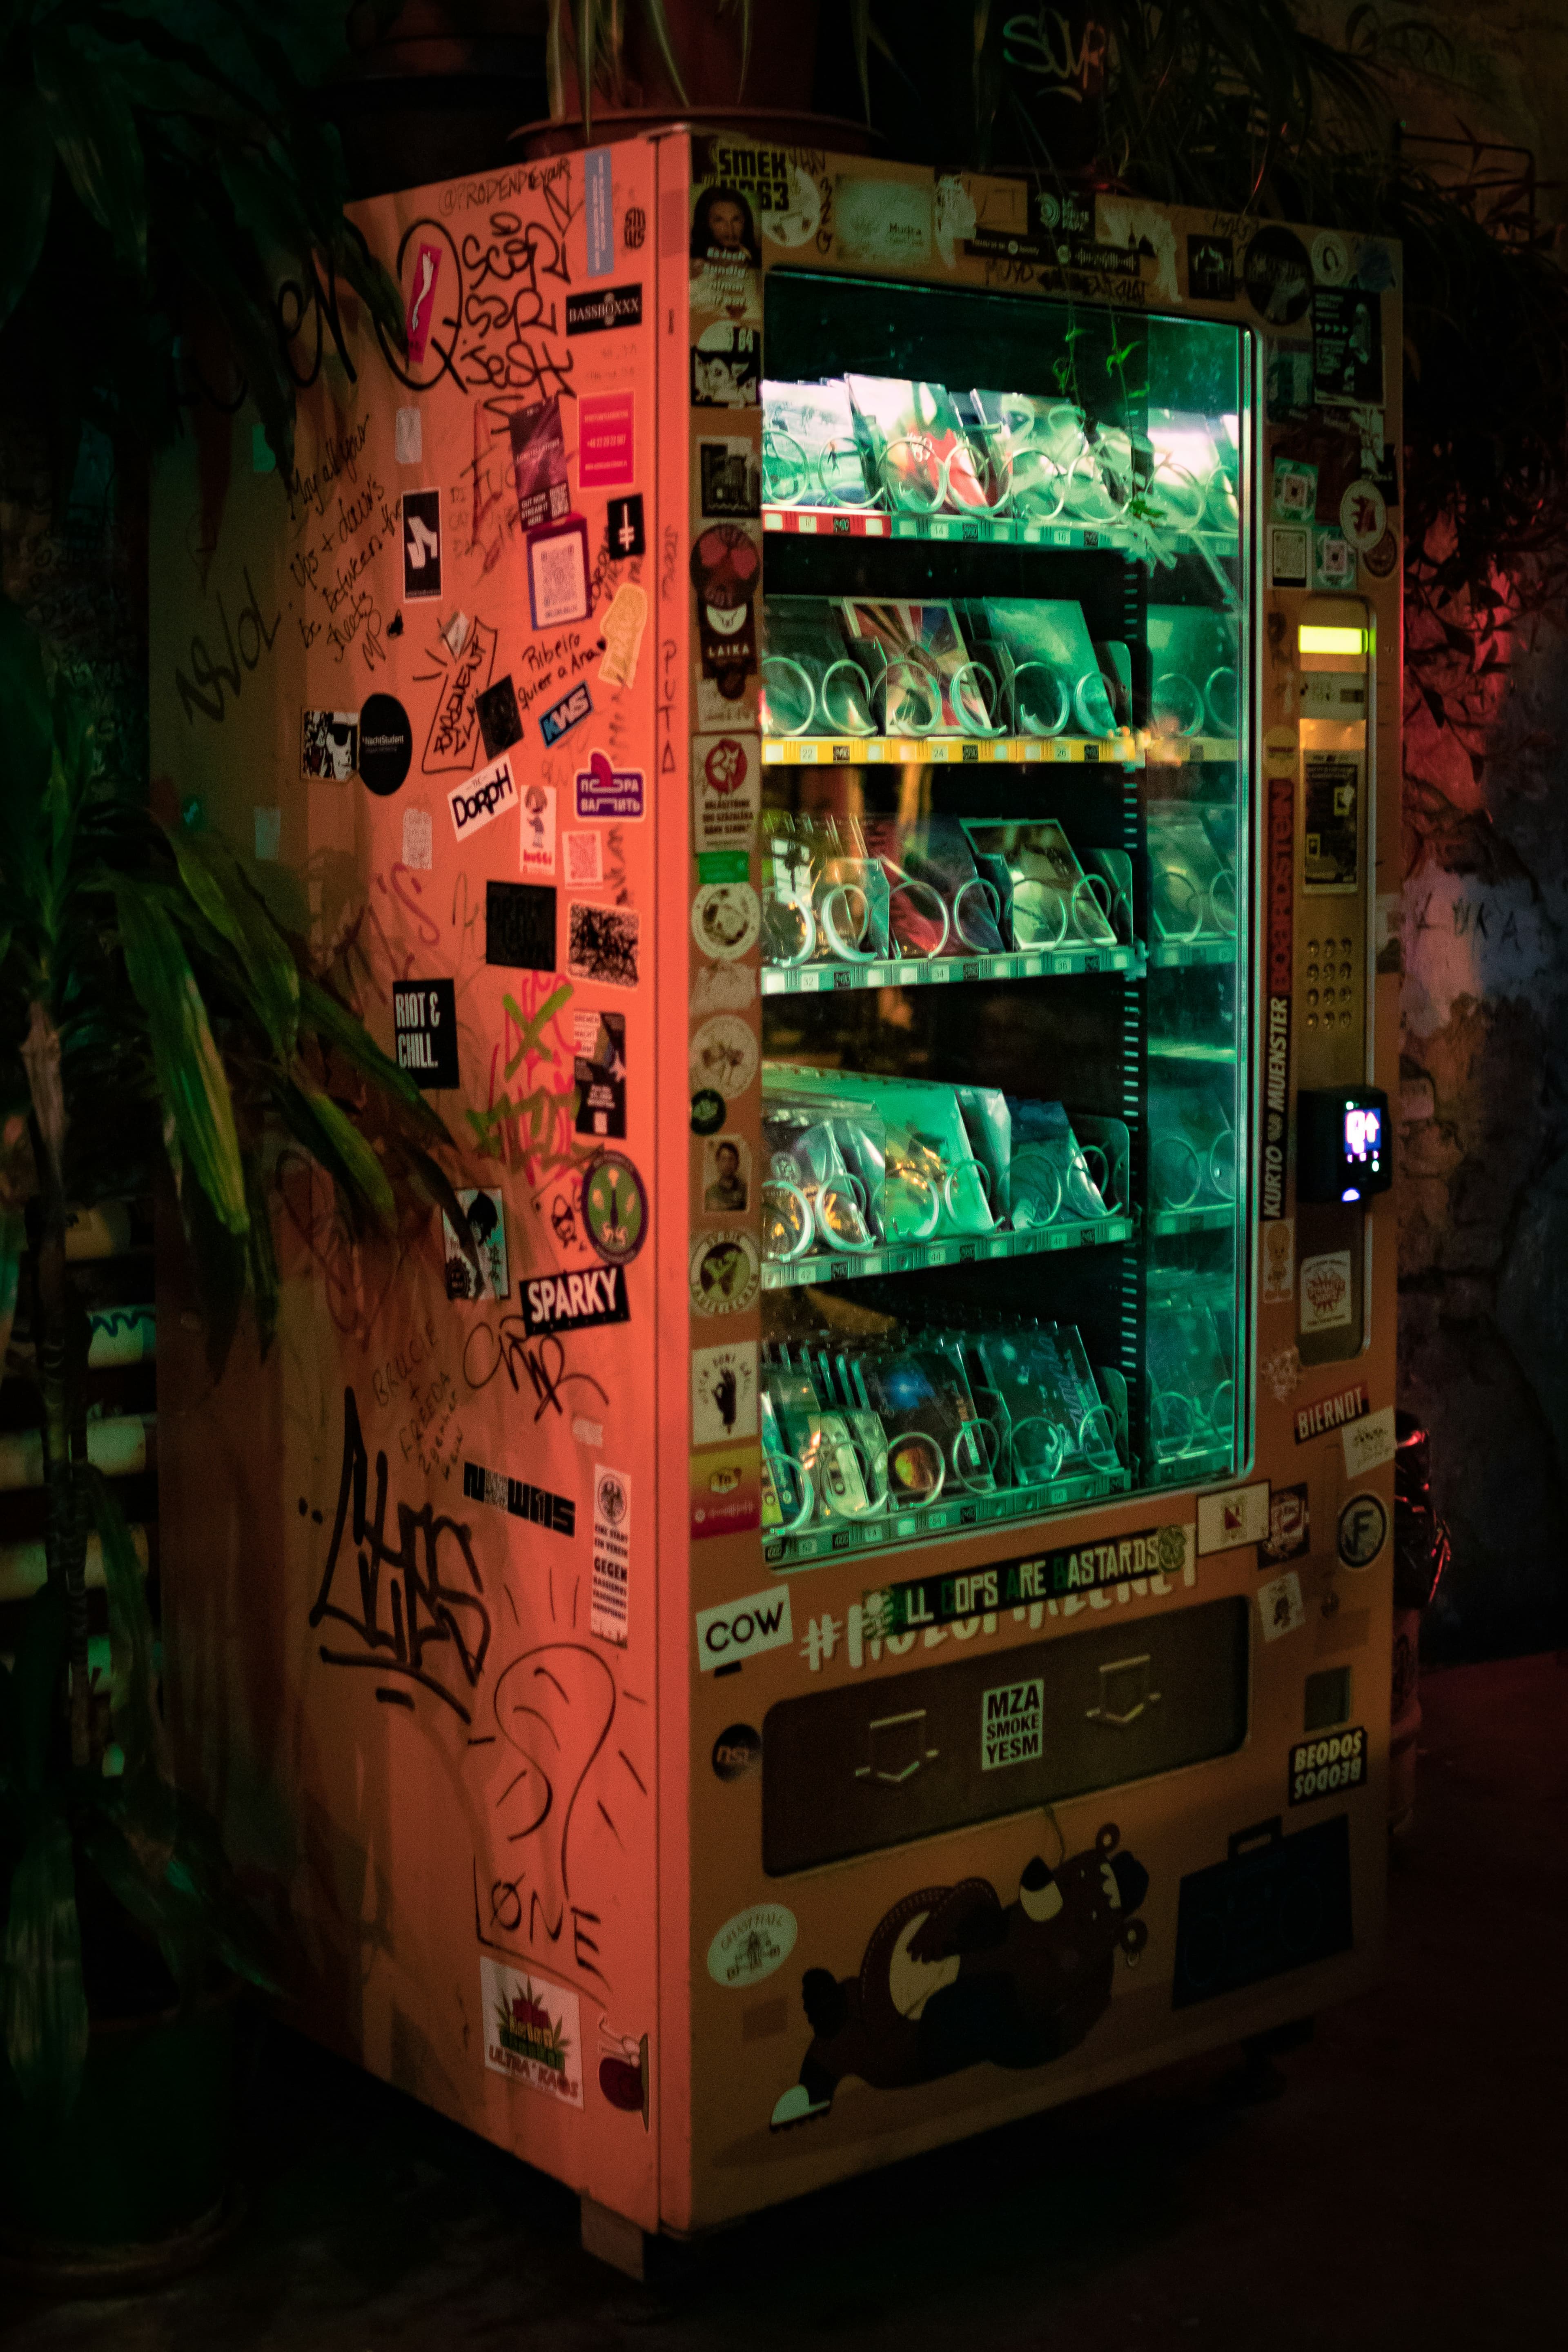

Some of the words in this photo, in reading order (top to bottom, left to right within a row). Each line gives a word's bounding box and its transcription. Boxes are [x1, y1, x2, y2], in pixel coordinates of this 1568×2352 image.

[718, 148, 787, 178] SMEK
[708, 645, 750, 657] LAIKA
[542, 686, 589, 742] KWS
[395, 991, 425, 1029] RIOT
[397, 1032, 439, 1069] CHILL.
[1267, 997, 1288, 1114] MUENSTER
[1263, 1145, 1284, 1219] KURTO
[528, 1267, 617, 1324] SPARKY
[1297, 1387, 1364, 1440] BIERNOT
[594, 1556, 628, 1583] GEGEN
[1054, 1535, 1159, 1592] BASTARDS
[706, 1602, 784, 1652] COW
[987, 1685, 1039, 1718] MZA
[986, 1734, 1039, 1764] YESM
[987, 1716, 1039, 1742] SMOKE
[1294, 1730, 1362, 1774] BEODOS
